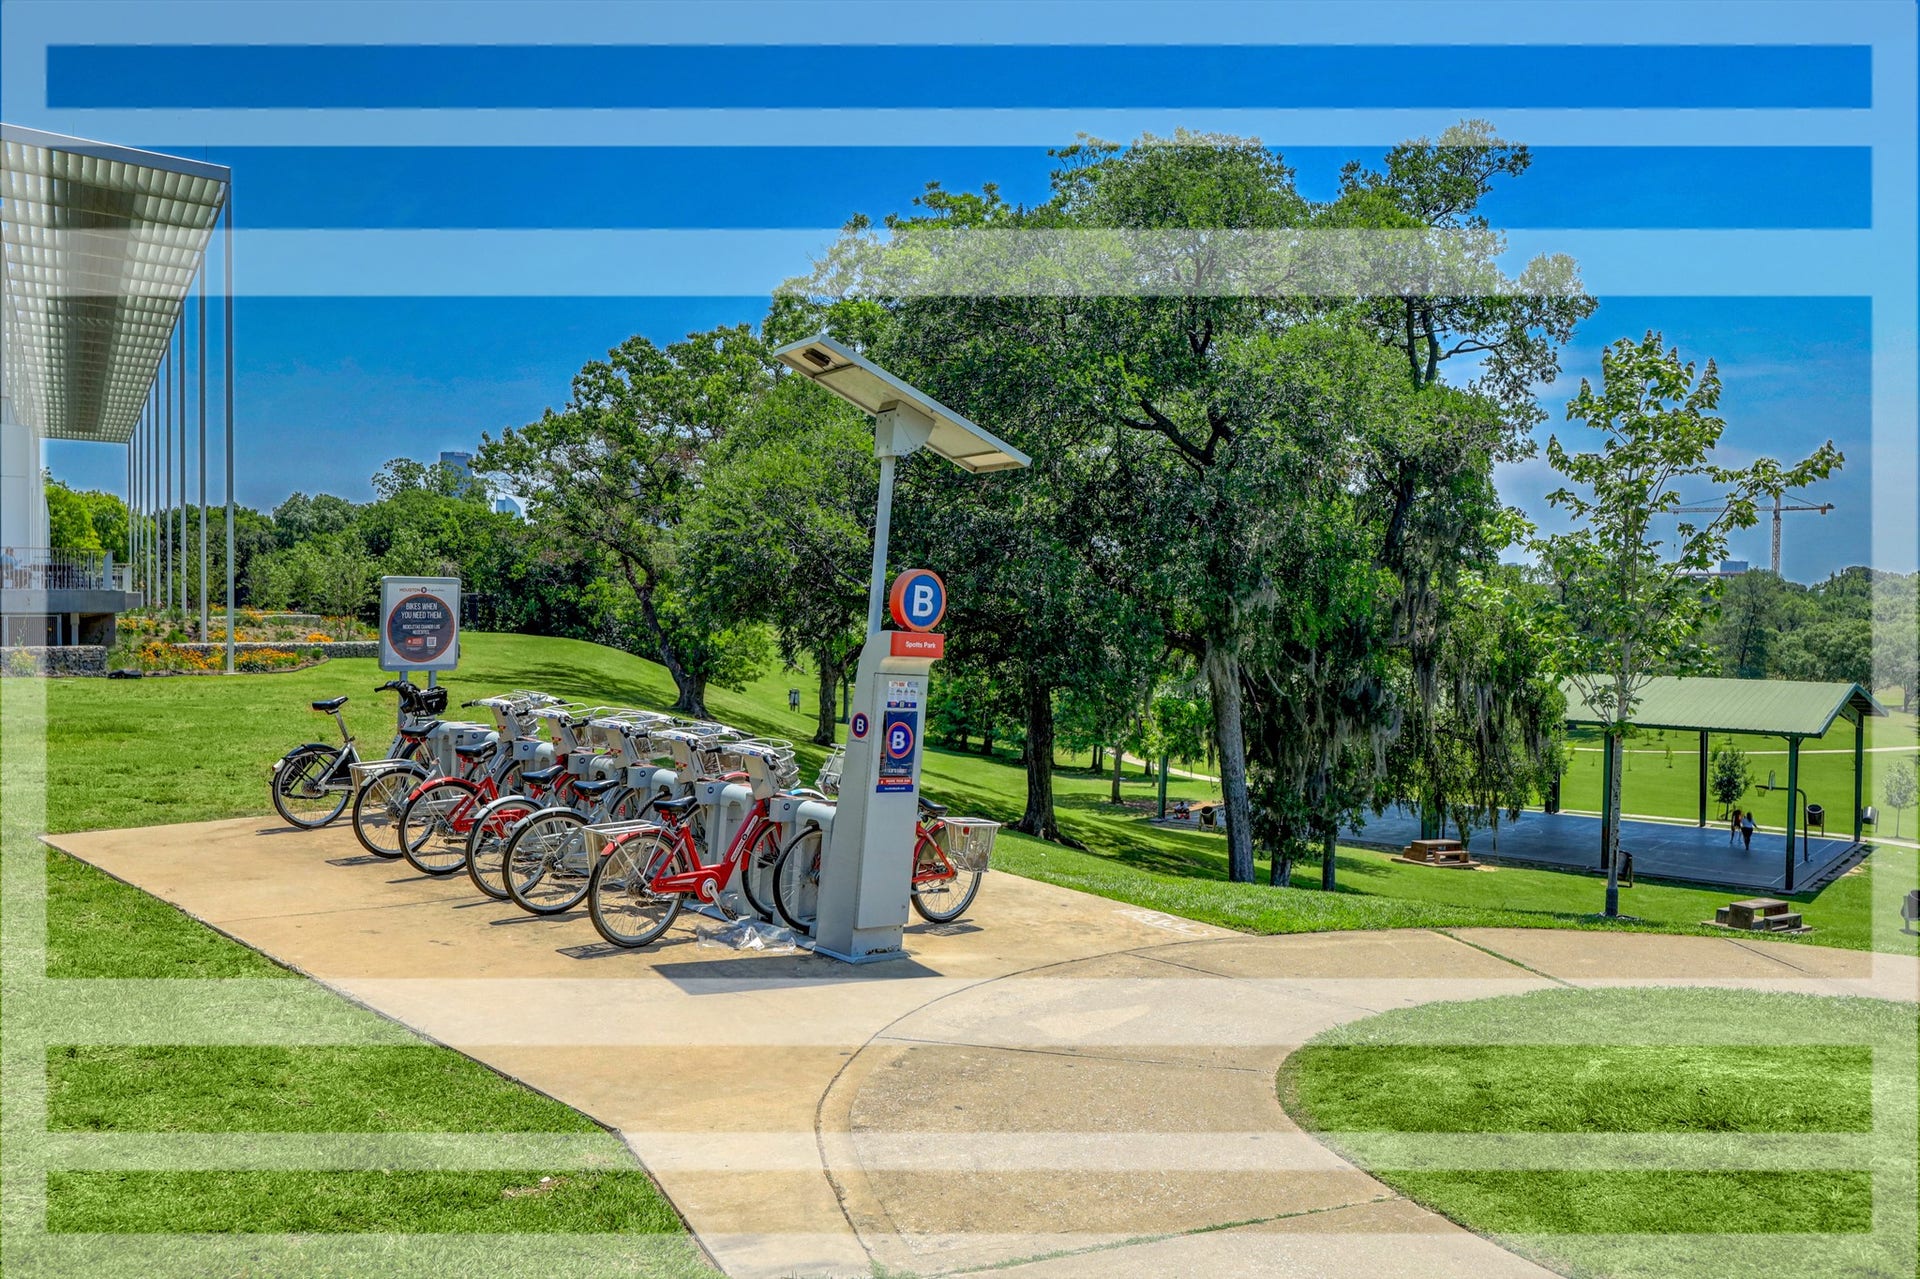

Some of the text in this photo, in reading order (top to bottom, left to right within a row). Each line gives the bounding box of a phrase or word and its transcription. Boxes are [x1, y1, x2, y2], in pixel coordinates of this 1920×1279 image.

[405, 602, 438, 610] BIKES WHEN
[912, 584, 934, 617] B
[401, 611, 412, 619] YOU
[412, 611, 426, 619] NEED
[905, 640, 937, 649] Spotts Park
[856, 718, 865, 732] B
[891, 731, 905, 749] B
